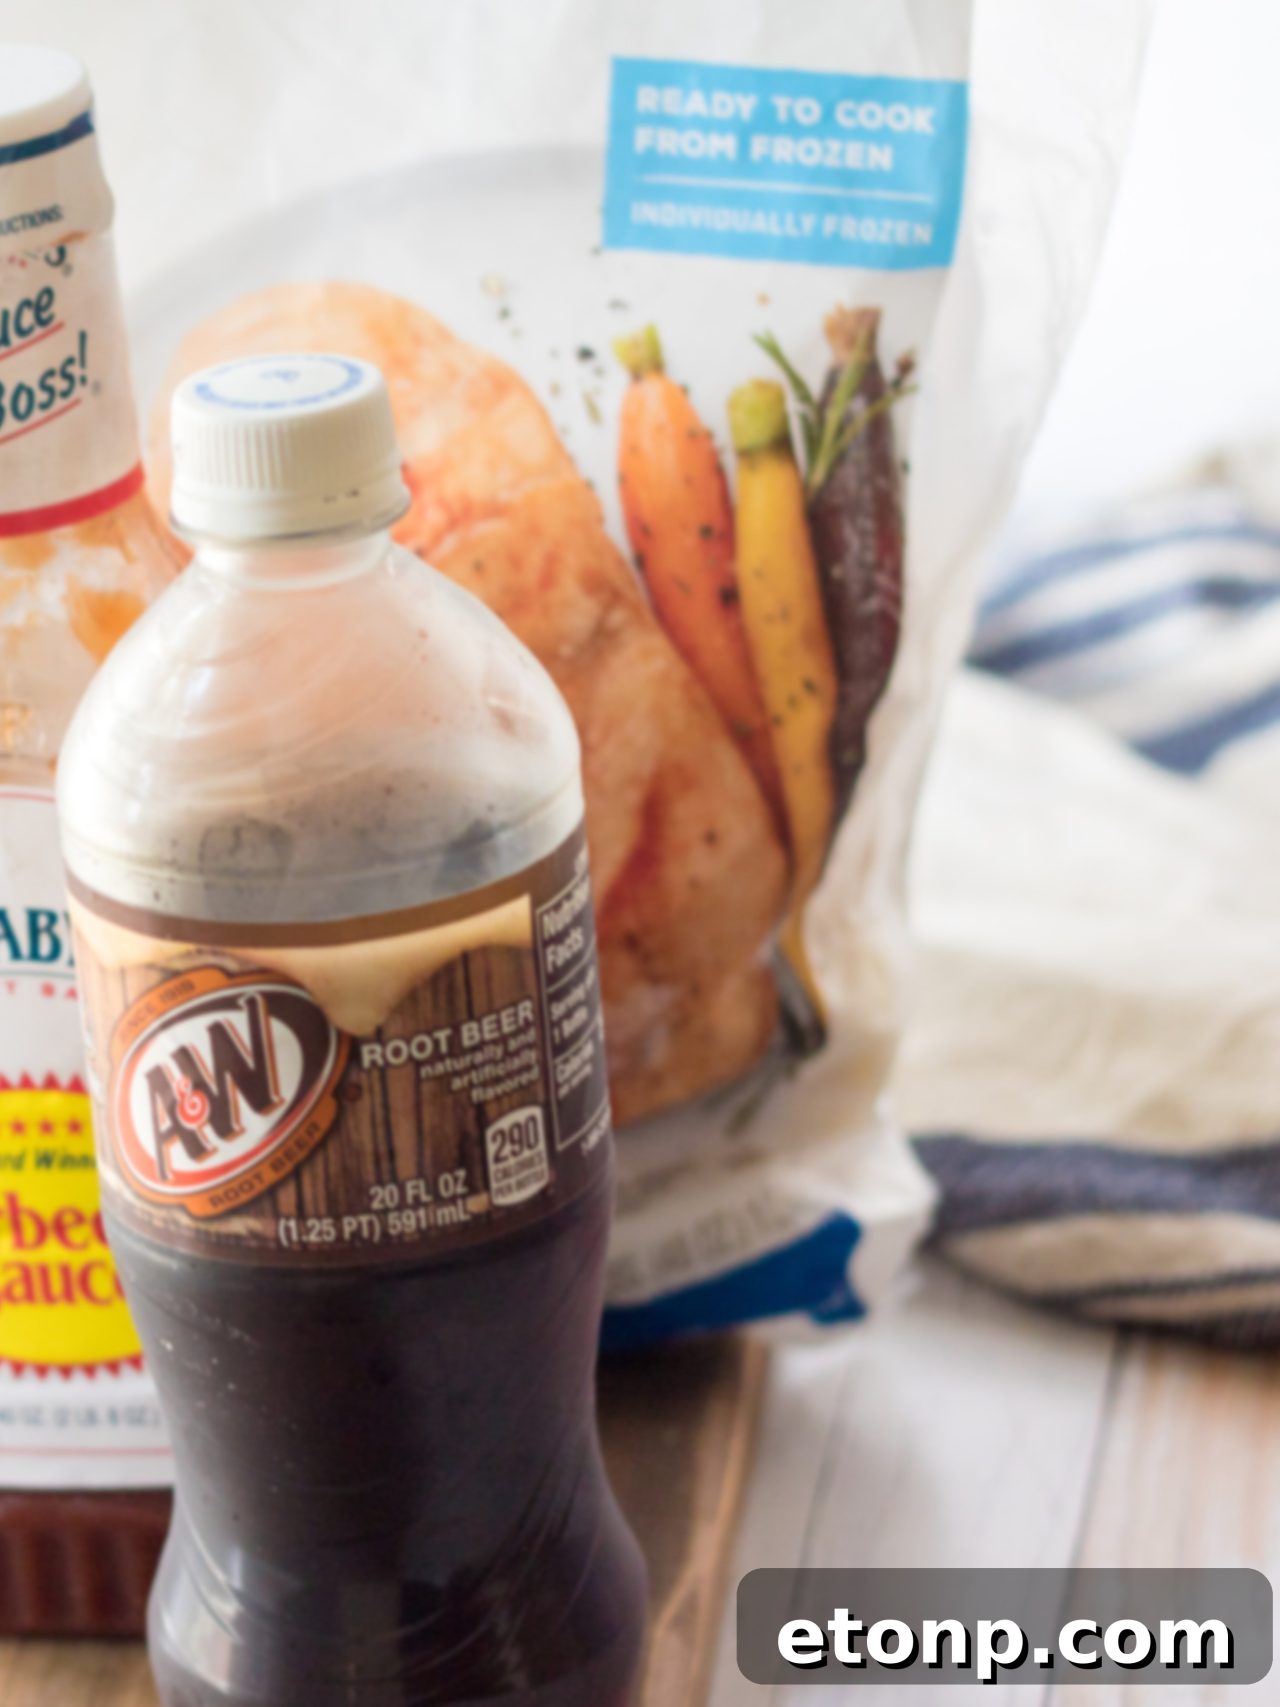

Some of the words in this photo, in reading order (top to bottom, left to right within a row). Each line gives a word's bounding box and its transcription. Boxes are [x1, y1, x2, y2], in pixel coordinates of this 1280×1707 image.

[636, 84, 759, 124] READY
[773, 94, 823, 126] TO
[835, 100, 935, 134] COOK
[634, 125, 738, 162] FROM
[750, 133, 894, 172] FROZEN
[631, 202, 816, 238] INDIVIDUALLY
[822, 213, 933, 246] FROZEN
[360, 1027, 453, 1071] ROOT
[461, 999, 535, 1049] BEER
[419, 1042, 504, 1080] naturally
[507, 1025, 536, 1054] and
[144, 990, 287, 1182] A&W
[208, 1170, 266, 1209] ROOT
[270, 1120, 320, 1174] BEER
[490, 1113, 541, 1165] 290
[369, 1183, 399, 1211] 20
[406, 1178, 433, 1205] FL
[438, 1167, 469, 1198] OZ
[278, 1216, 337, 1249] (1.25
[342, 1213, 381, 1244] PT)
[387, 1208, 428, 1236] 591
[436, 1198, 471, 1227] mL
